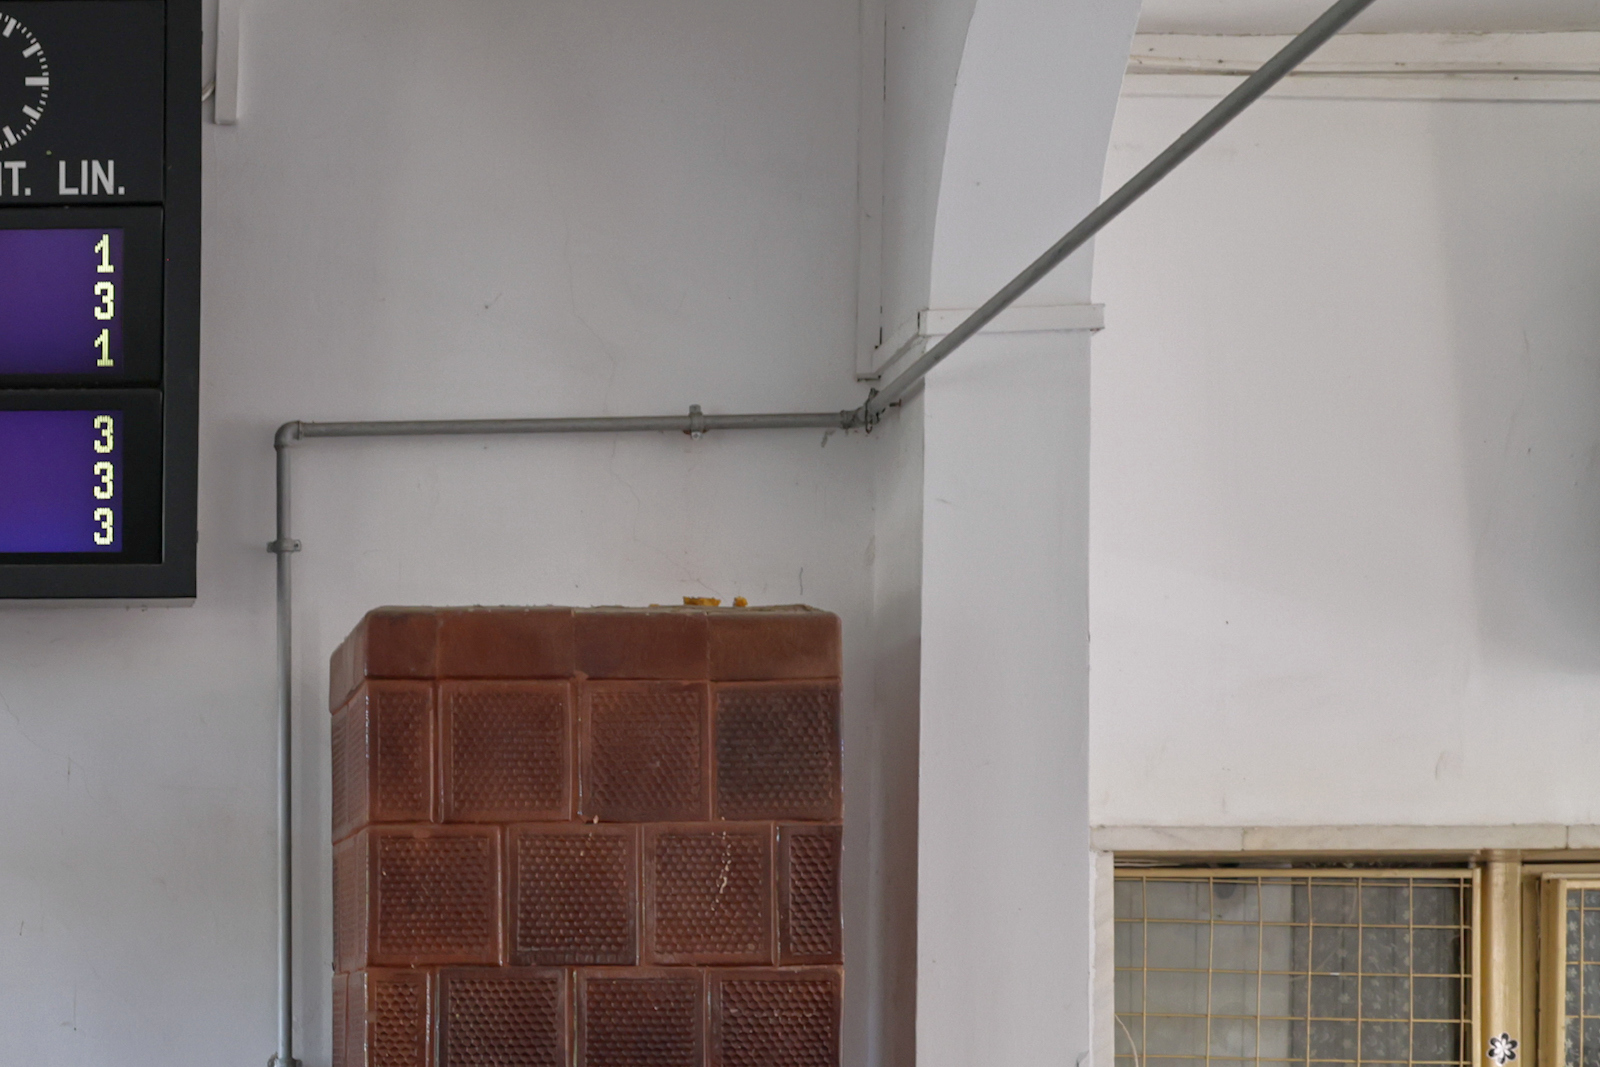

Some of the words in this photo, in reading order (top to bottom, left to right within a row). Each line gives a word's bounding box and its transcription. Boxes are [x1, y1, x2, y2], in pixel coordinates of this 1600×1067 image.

[59, 160, 124, 194] LIN.
[95, 235, 113, 272] 1
[95, 282, 113, 319] 3
[95, 329, 113, 366] 1
[94, 416, 113, 453] 3
[94, 462, 113, 499] 3
[94, 508, 112, 544] 3
